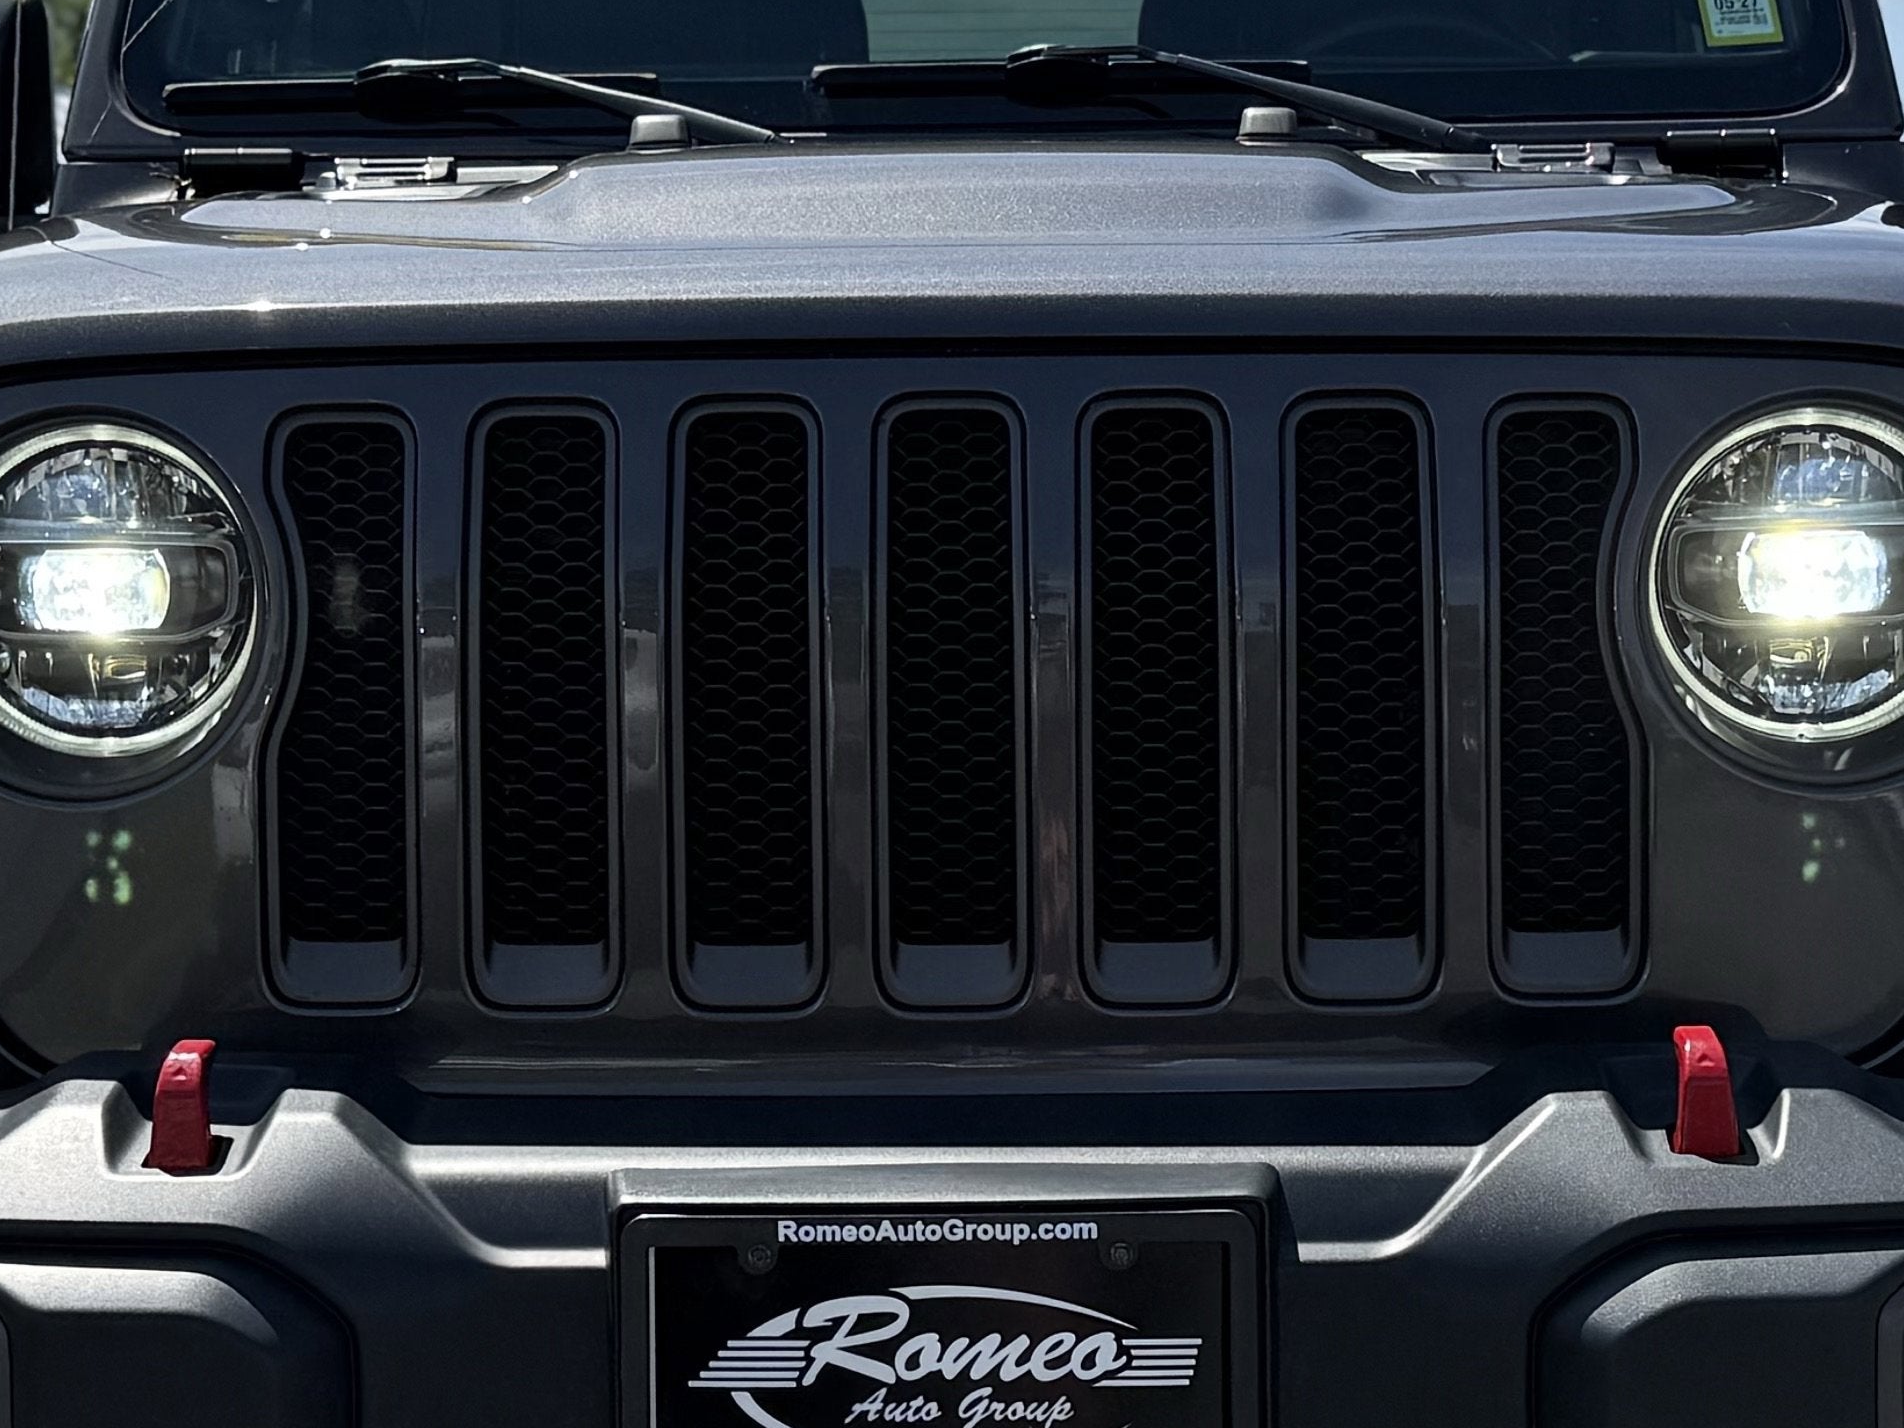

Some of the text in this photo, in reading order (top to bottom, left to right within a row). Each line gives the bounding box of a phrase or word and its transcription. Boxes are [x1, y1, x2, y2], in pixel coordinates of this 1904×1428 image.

[776, 1219, 1099, 1244] RomeoAutoGroup.com
[800, 1294, 1127, 1387] Romeo
[844, 1386, 942, 1424] Auto
